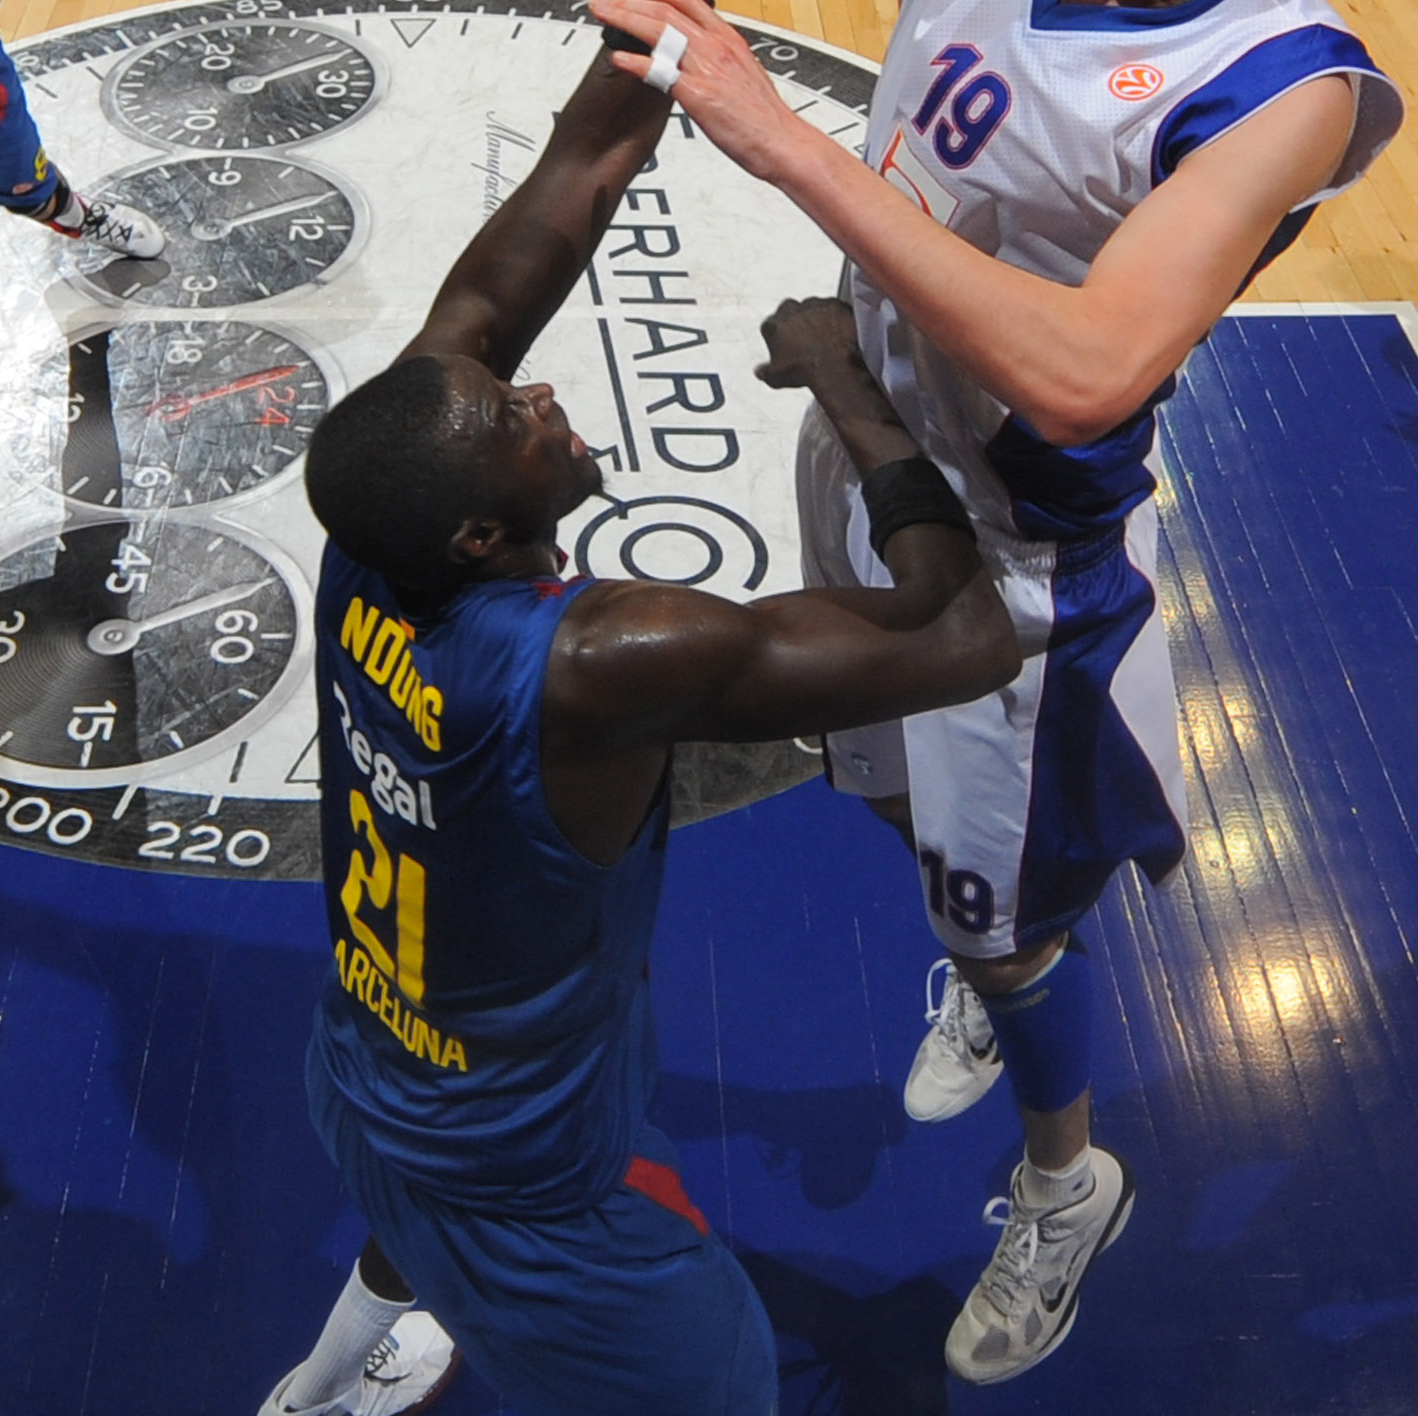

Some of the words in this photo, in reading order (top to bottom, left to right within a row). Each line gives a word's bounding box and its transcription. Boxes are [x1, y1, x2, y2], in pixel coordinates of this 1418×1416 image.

[201, 42, 235, 72] 20
[748, 36, 800, 64] 70
[317, 69, 350, 100] 30
[911, 42, 1012, 171] 19
[183, 105, 217, 133] 10
[289, 214, 326, 243] 12
[593, 110, 741, 474] ERHARD
[167, 337, 203, 365] 18
[255, 385, 297, 428] 24
[104, 543, 155, 595] 45
[209, 609, 261, 665] 60
[67, 699, 119, 744] 15
[137, 820, 271, 869] 220
[340, 788, 427, 1011] 21
[922, 850, 995, 936] 19
[333, 938, 468, 1073] ARCELONA
